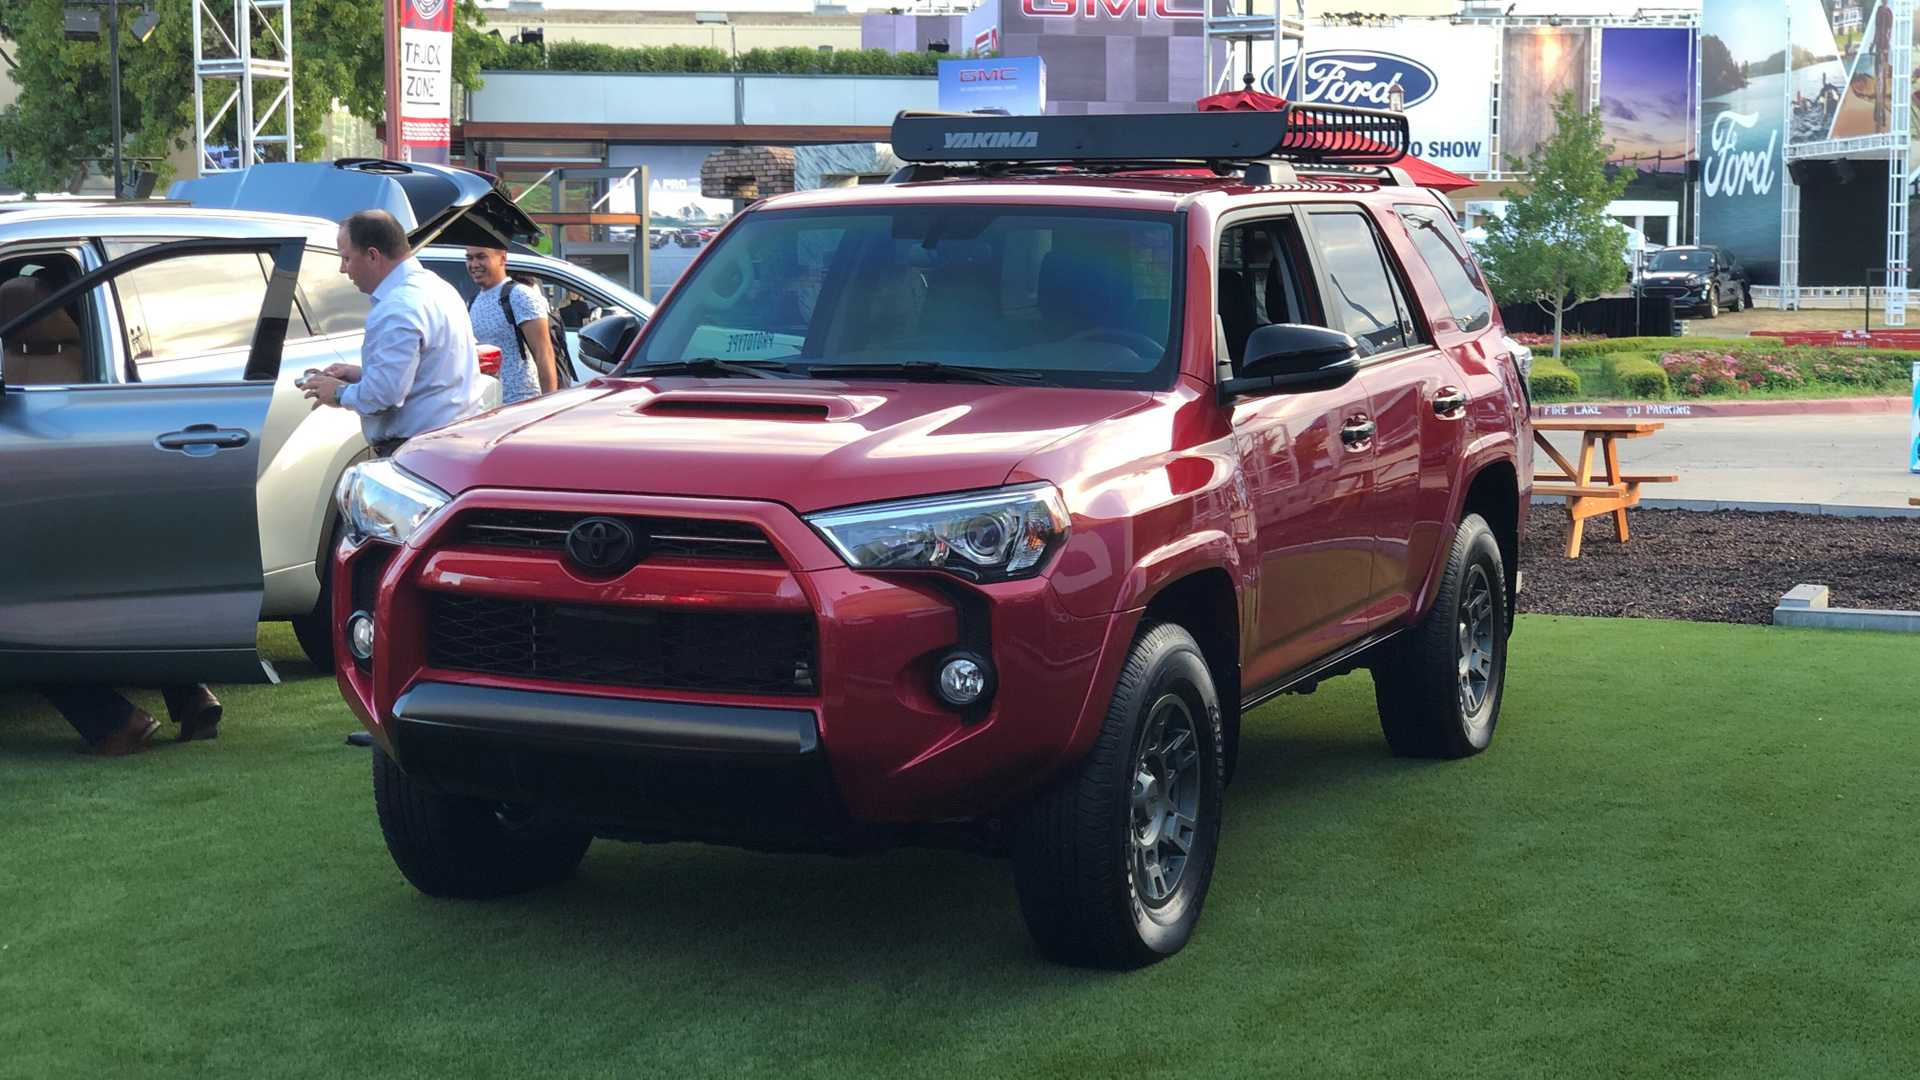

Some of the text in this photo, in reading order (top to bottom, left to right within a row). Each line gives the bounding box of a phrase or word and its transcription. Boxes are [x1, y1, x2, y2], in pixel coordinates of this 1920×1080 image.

[405, 42, 441, 65] TRUCK
[960, 68, 1018, 82] GMC
[1303, 58, 1403, 104] Ford
[406, 76, 435, 97] ZONE
[943, 131, 1040, 149] YAKIMA
[1428, 140, 1482, 158] SHOW
[1704, 110, 1777, 197] Ford
[1544, 405, 1568, 415] FIRE
